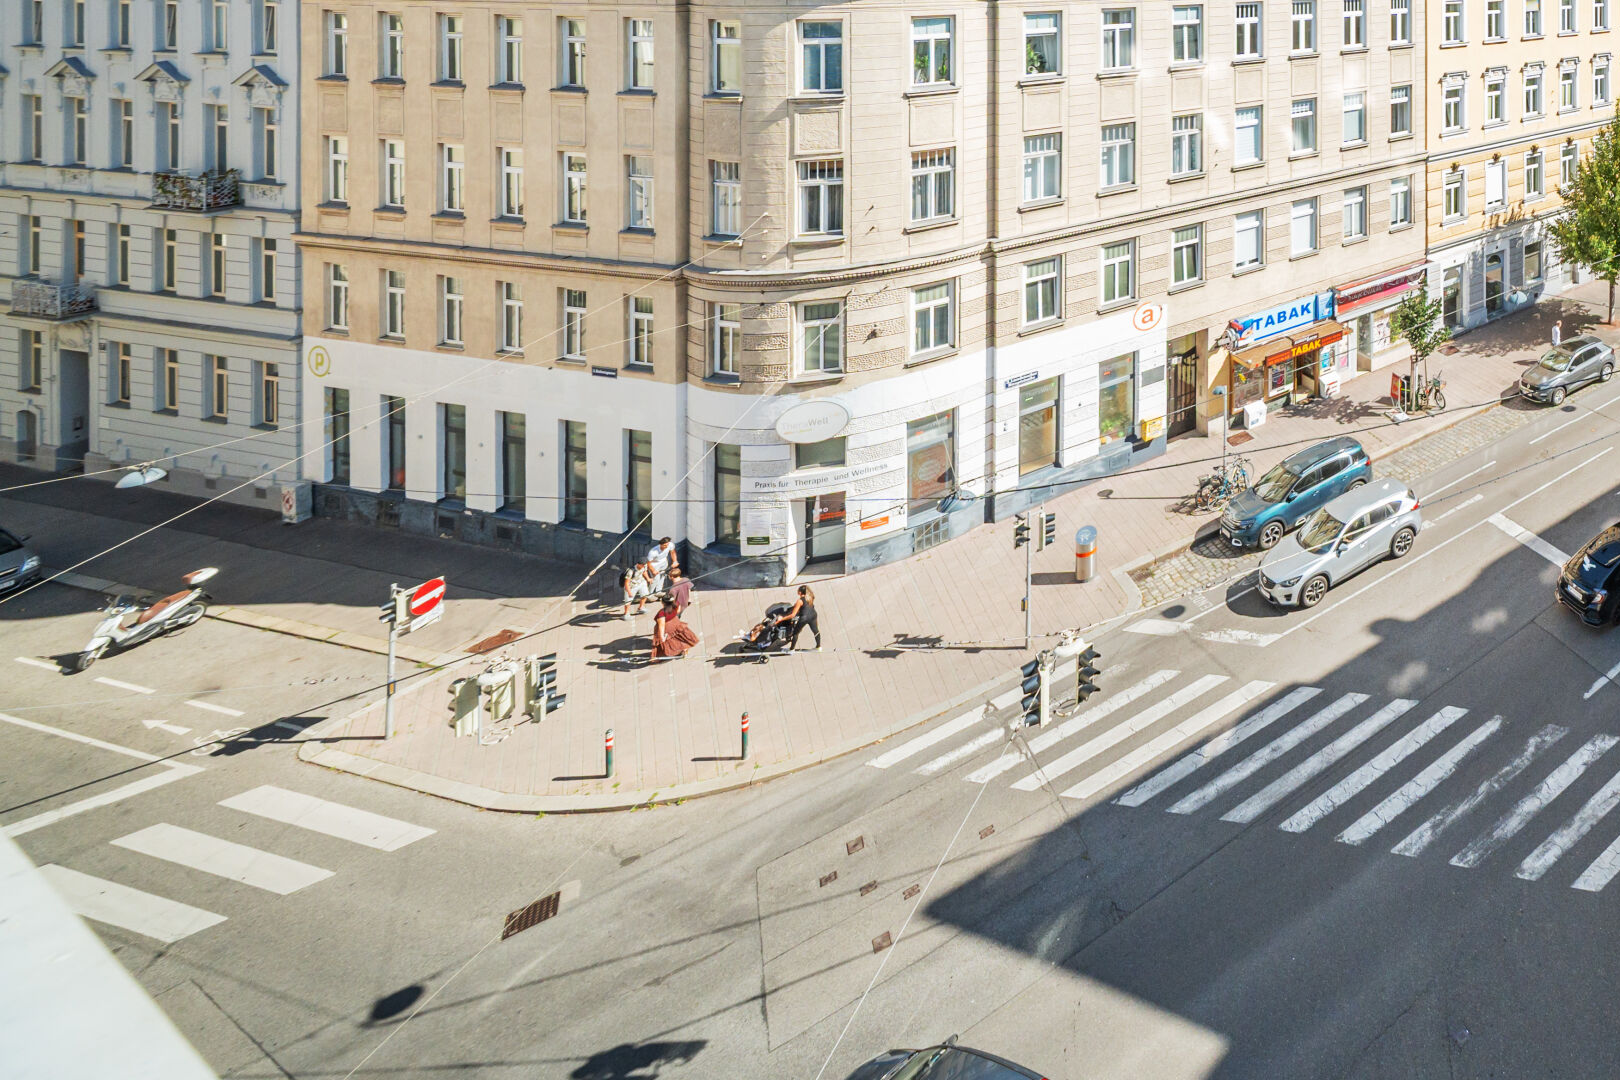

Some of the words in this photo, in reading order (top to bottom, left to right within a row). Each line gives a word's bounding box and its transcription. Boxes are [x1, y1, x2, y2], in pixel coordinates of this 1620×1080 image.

[1252, 302, 1311, 331] TABAK
[1291, 339, 1321, 357] TABAK
[755, 480, 777, 489] Praxis
[795, 476, 829, 487] Therapie
[833, 472, 849, 481] und
[851, 463, 888, 478] Wellness
